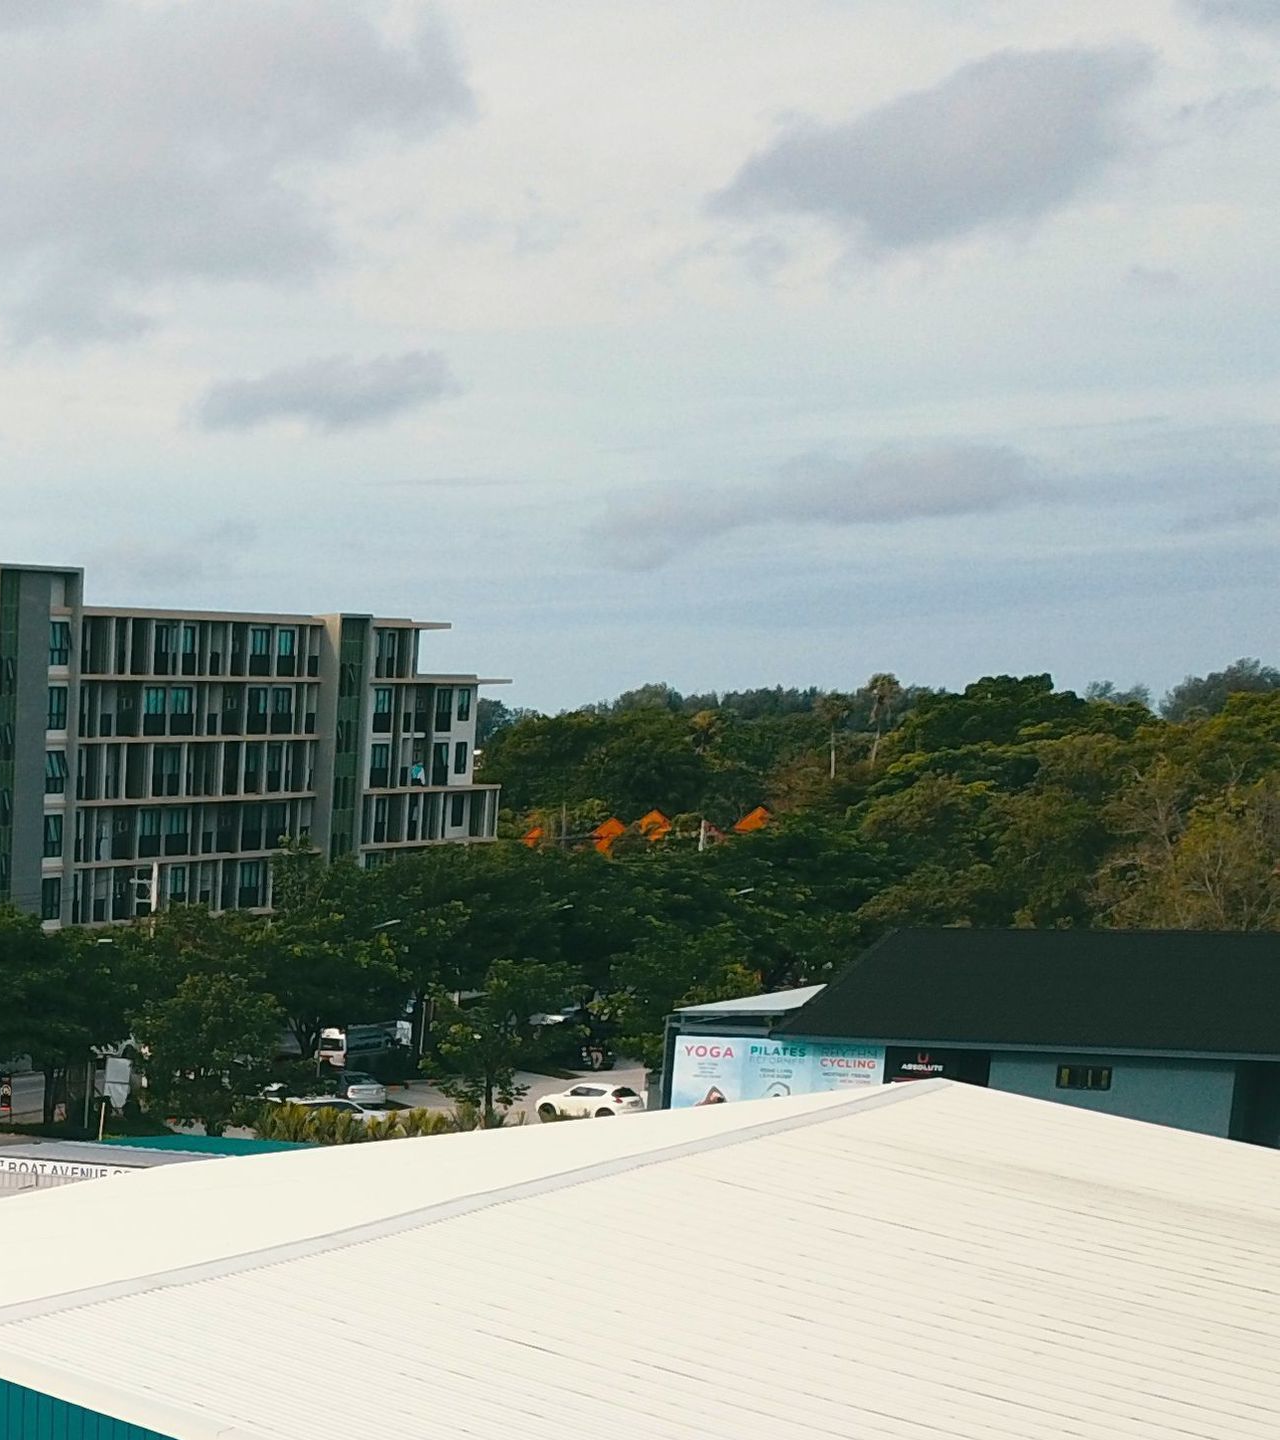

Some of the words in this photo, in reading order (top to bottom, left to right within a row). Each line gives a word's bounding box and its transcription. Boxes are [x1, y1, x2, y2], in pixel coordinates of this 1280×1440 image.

[684, 1045, 735, 1059] YOGA
[750, 1045, 807, 1057] PILATES
[820, 1057, 876, 1069] CYCLING
